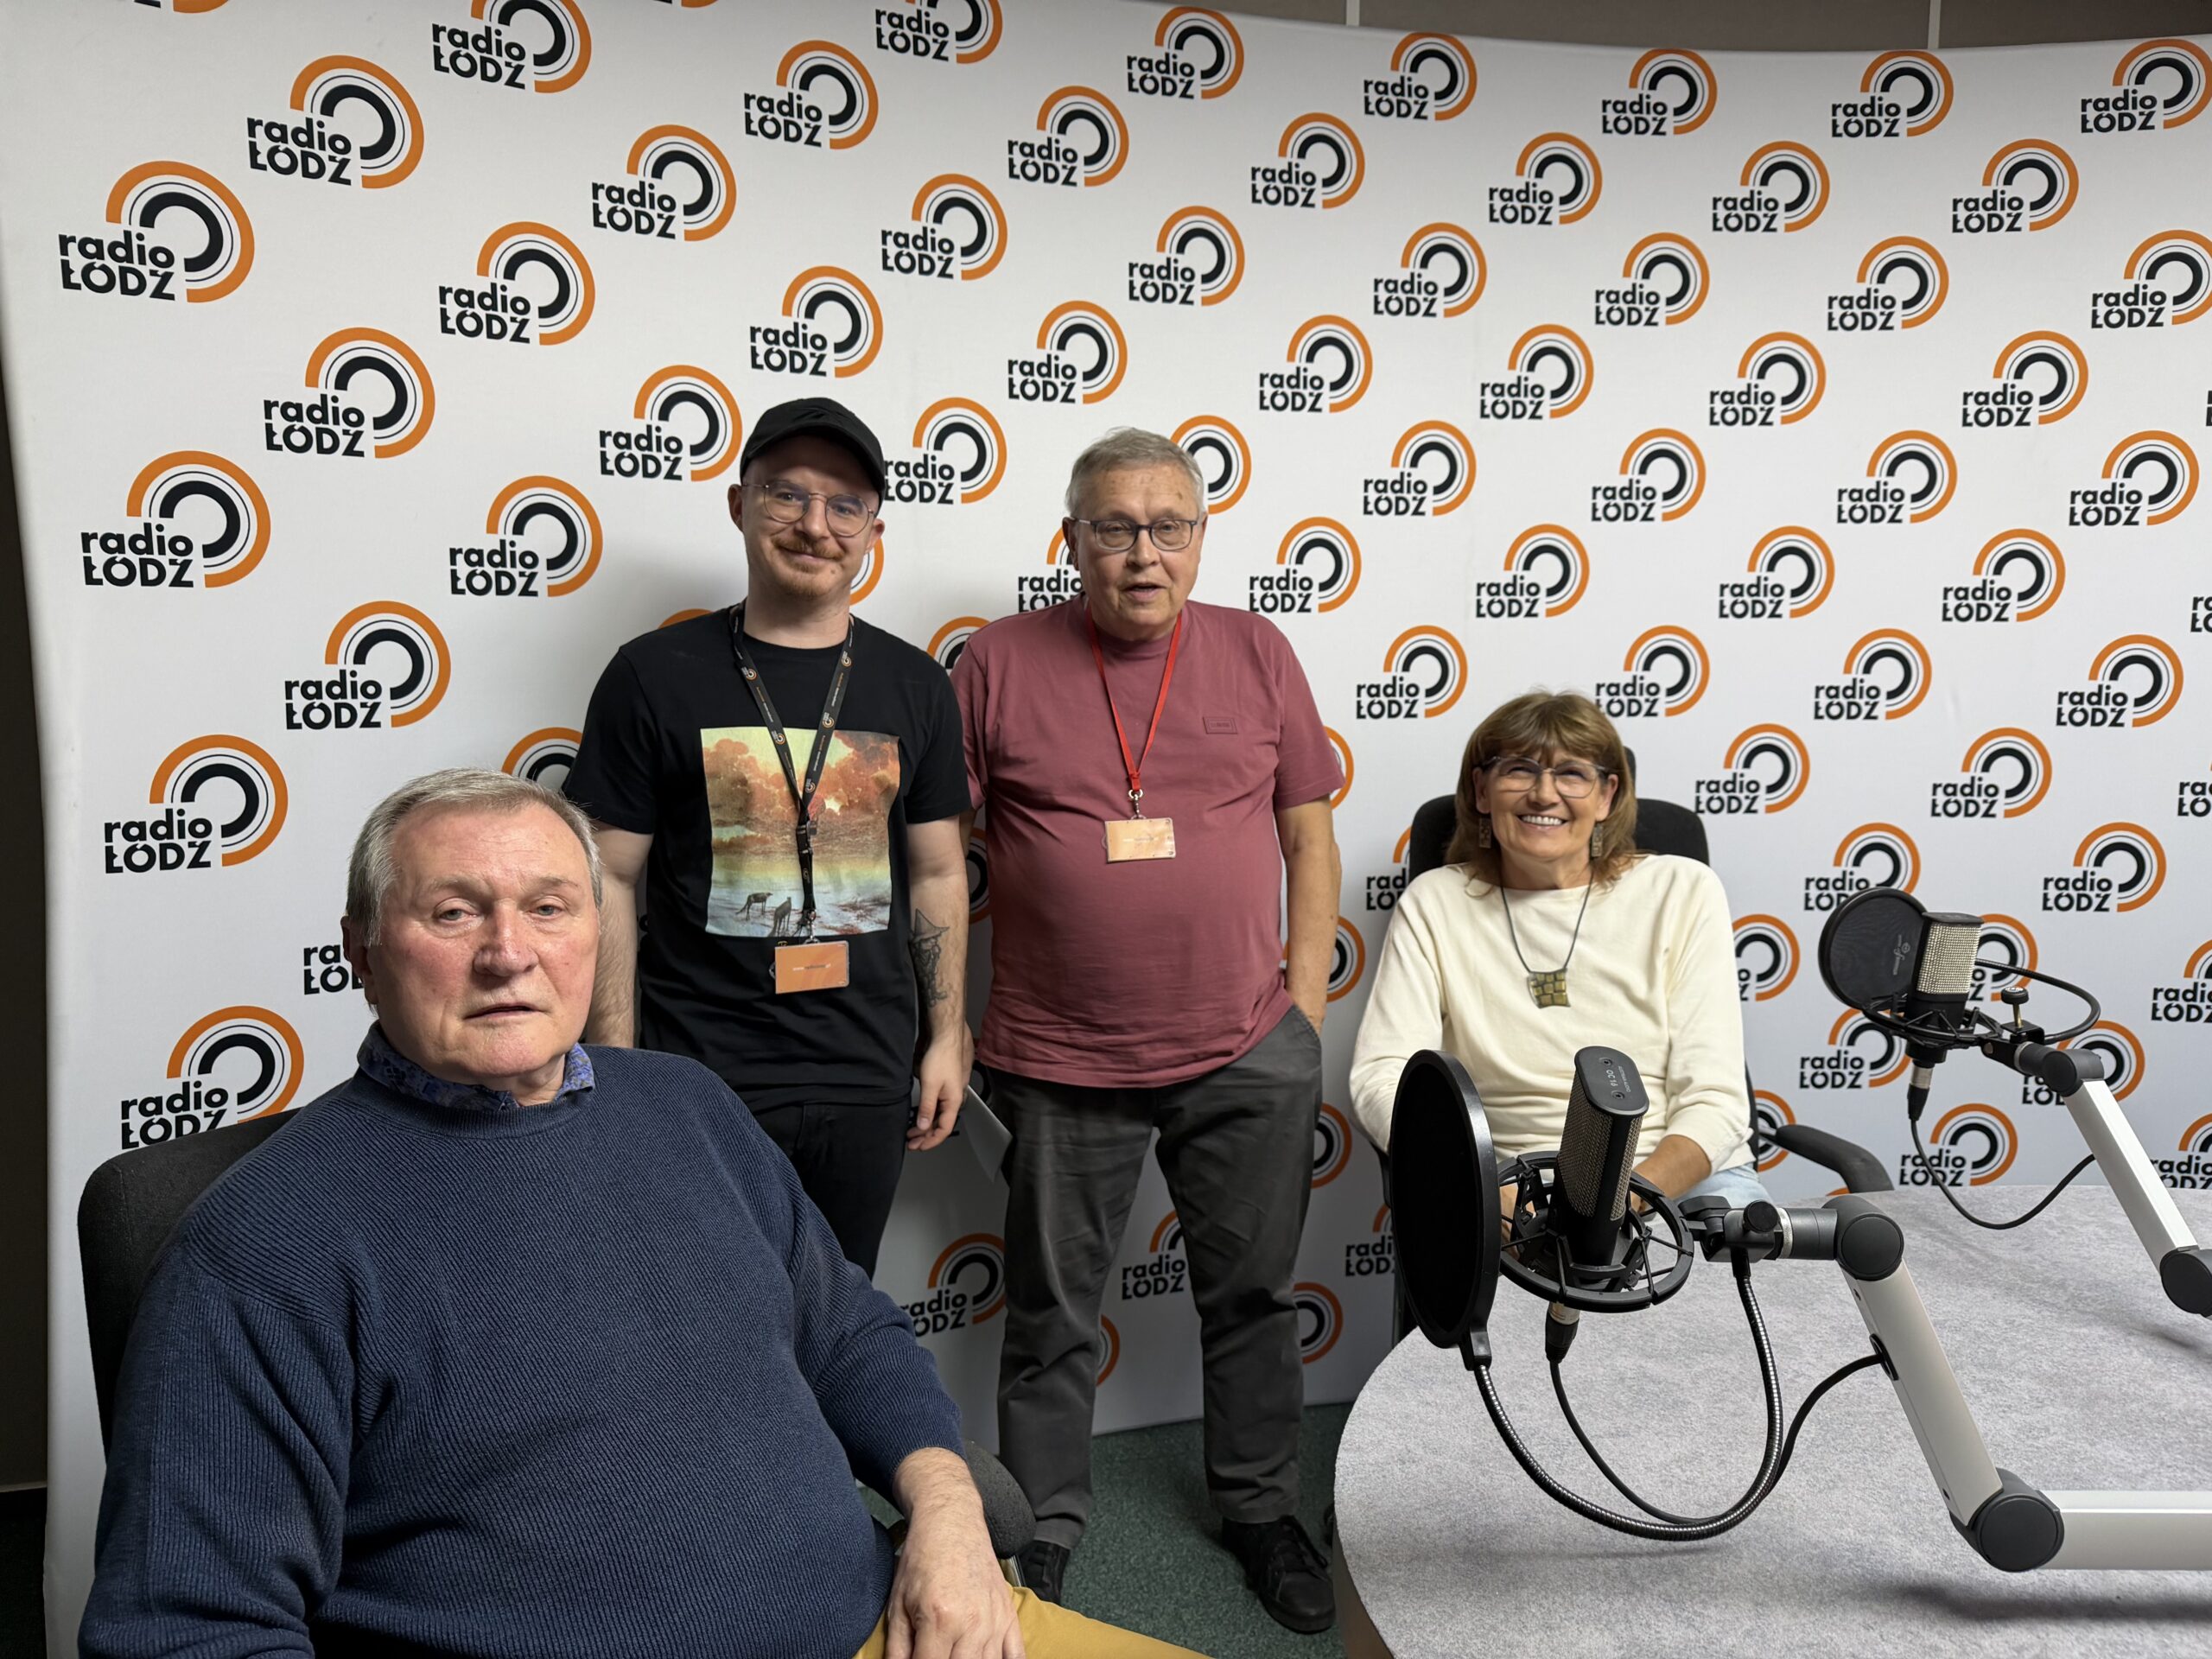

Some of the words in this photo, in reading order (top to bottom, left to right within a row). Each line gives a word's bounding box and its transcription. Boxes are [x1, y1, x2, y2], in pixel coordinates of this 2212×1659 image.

[875, 9, 950, 38] radio
[431, 23, 526, 62] radio
[1127, 54, 1195, 78] radio
[1363, 76, 1429, 99] radio
[744, 92, 823, 123] radio
[1601, 93, 1668, 116] radio
[1831, 96, 1901, 118] radio
[2081, 88, 2158, 113] radio
[246, 117, 352, 156] radio
[1007, 138, 1078, 164] radio
[1251, 162, 1317, 187] radio
[591, 181, 677, 213] radio
[1489, 182, 1554, 205] radio
[1713, 190, 1779, 213] radio
[1952, 189, 2024, 213] radio
[58, 232, 175, 269] radio
[880, 227, 955, 255] radio
[1128, 257, 1196, 283] radio
[1374, 273, 1439, 296] radio
[1595, 283, 1661, 306] radio
[2092, 283, 2167, 308] radio
[438, 284, 531, 316] radio
[1827, 288, 1897, 310] radio
[749, 323, 828, 352] radio
[1007, 354, 1077, 380] radio
[1259, 367, 1325, 391] radio
[1480, 376, 1545, 399] radio
[1710, 384, 1776, 405] radio
[1962, 384, 2034, 406] radio
[264, 395, 365, 429] radio
[599, 425, 683, 454] radio
[884, 454, 955, 480] radio
[1363, 472, 1428, 495] radio
[1592, 479, 1657, 501] radio
[1837, 480, 1905, 503] radio
[2069, 482, 2143, 505] radio
[80, 523, 194, 557] radio
[448, 540, 539, 570] radio
[1018, 569, 1083, 592] radio
[1249, 569, 1313, 592] radio
[1476, 575, 1541, 597] radio
[1719, 576, 1785, 598] radio
[1942, 579, 2012, 601] radio
[284, 670, 383, 701] radio
[1357, 676, 1420, 698] radio
[1596, 676, 1661, 697] radio
[1815, 678, 1881, 700] radio
[2057, 684, 2128, 707] radio
[1695, 772, 1760, 794] radio
[1932, 776, 1999, 798] radio
[104, 808, 213, 843] radio
[1366, 867, 1406, 890] rad
[1805, 870, 1870, 891] radio
[2043, 870, 2113, 893] radio
[303, 965, 365, 995] ŁÓ
[1800, 1050, 1865, 1070] radio
[121, 1080, 229, 1121] radio
[1901, 1147, 1967, 1168] radio
[1345, 1235, 1394, 1257] radi
[1122, 1254, 1186, 1281] radio
[1345, 1256, 1394, 1276] ŁÓD
[913, 1307, 967, 1337] ÓDŹ
